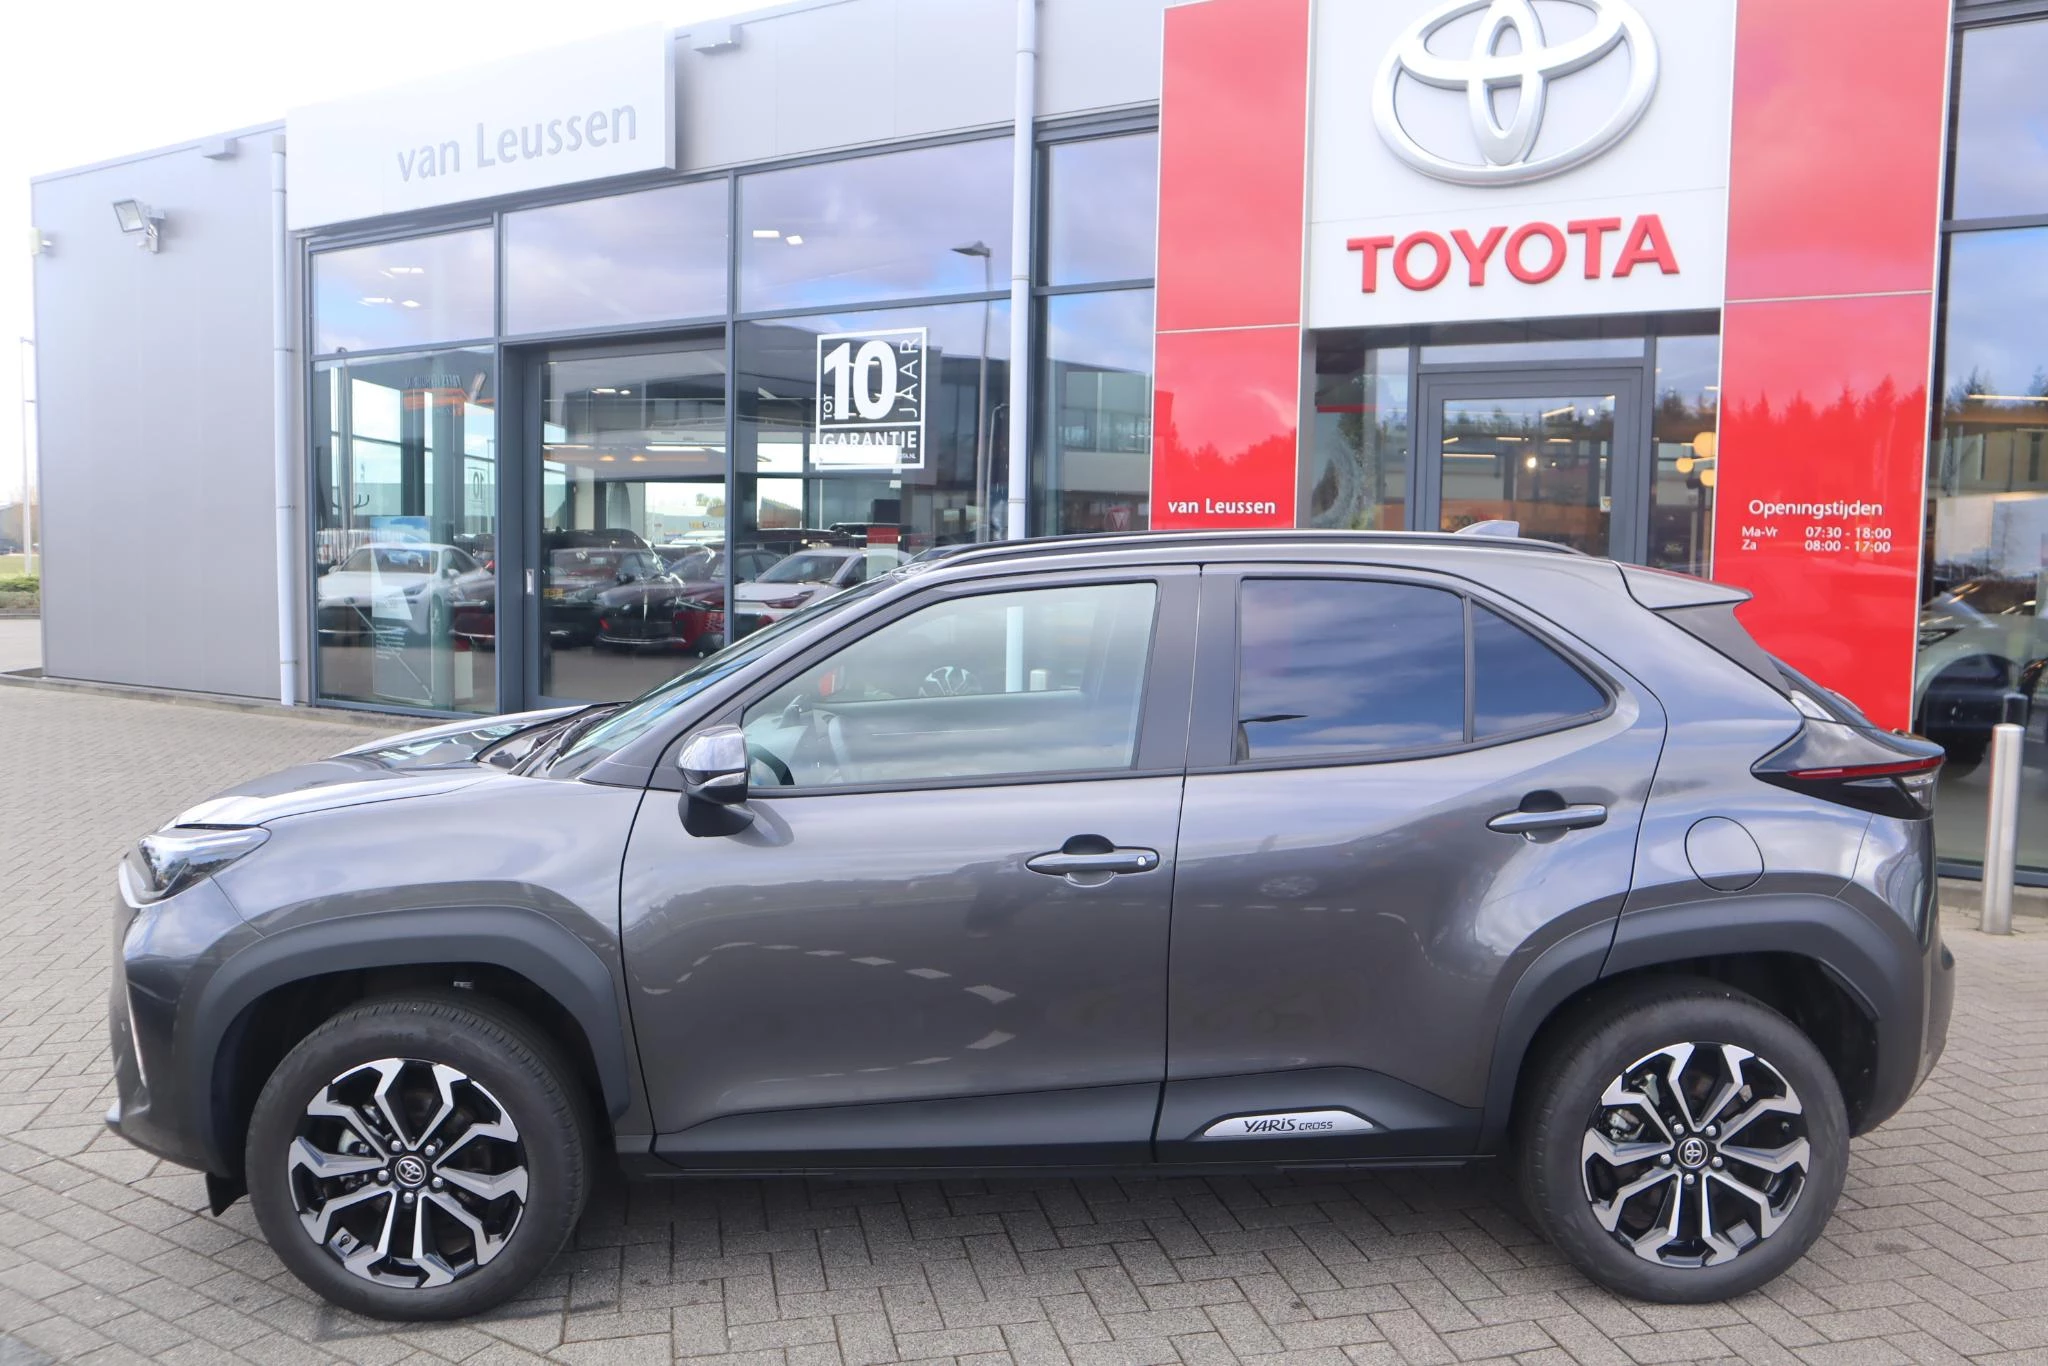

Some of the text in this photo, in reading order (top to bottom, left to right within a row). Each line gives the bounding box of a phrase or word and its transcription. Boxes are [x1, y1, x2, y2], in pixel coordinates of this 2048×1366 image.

[397, 104, 637, 183] van Leussen
[1346, 213, 1681, 294] TOYOTA
[823, 340, 898, 420] 10
[898, 337, 919, 418] JAAR
[823, 393, 833, 421] TOT
[822, 430, 917, 449] GARANTIE
[1167, 498, 1276, 515] van Leussen
[1748, 499, 1883, 520] Openingstijden
[1741, 526, 1778, 538] Ma-Vr
[1805, 526, 1842, 538] 07:30
[1855, 527, 1892, 540] 18:00
[1741, 538, 1757, 551] Za
[1804, 539, 1842, 552] 08:00
[1854, 541, 1891, 553] 17:00
[1298, 1121, 1334, 1131] CROSS
